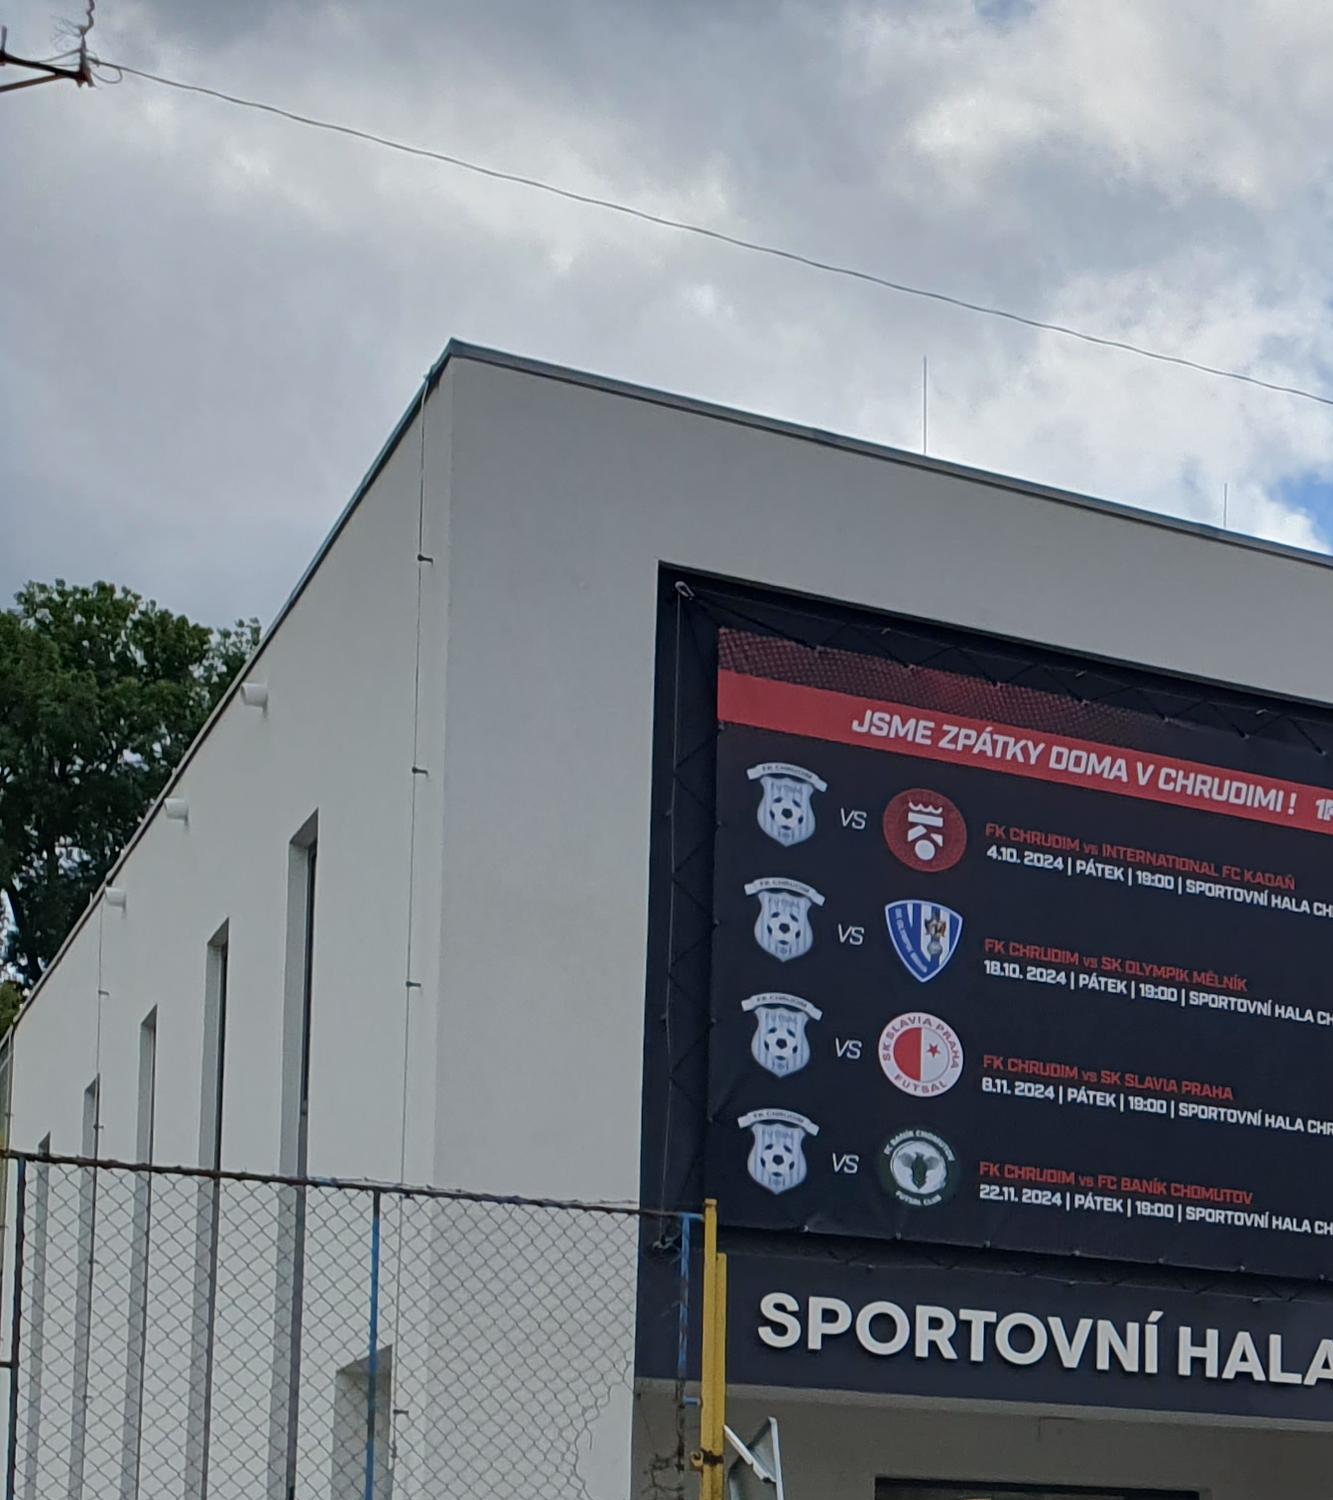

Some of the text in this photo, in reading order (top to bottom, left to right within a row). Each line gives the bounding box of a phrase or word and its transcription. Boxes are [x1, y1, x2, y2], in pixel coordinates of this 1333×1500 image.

[852, 709, 935, 745] JSME
[939, 725, 1045, 765] ZPÁTKY
[1049, 745, 1128, 782] DOMA
[1136, 761, 1154, 786] V
[1158, 767, 1284, 812] CHRUDIMI
[840, 807, 867, 830] VS
[985, 823, 1006, 839] FK
[1009, 827, 1080, 851] CHRUDIM
[1083, 842, 1098, 854] vs
[1102, 843, 1218, 877] INTERNATIONAL
[1222, 865, 1241, 881] FC
[986, 845, 1021, 863] 4.10.
[1024, 851, 1064, 870] 2024
[1076, 858, 1124, 882] PÁTEK
[1136, 870, 1174, 889] 19:00
[1186, 879, 1268, 906] SPORTOVNÍ
[1271, 894, 1310, 914] HALA
[838, 923, 865, 945] VS
[985, 939, 1247, 991] FK CHRUDIM vs SK OLYMPIK MĚLNÍK
[984, 960, 1023, 979] 18.10.
[1026, 967, 1066, 985] 2024
[1079, 973, 1127, 995] PÁTEK
[1139, 983, 1177, 1002] 19:00
[1189, 991, 1272, 1016] SPORTOVNÍ
[1275, 1004, 1314, 1023] HALA
[835, 1038, 862, 1060] VS
[882, 1016, 960, 1070] SK SLAVIA PRAHA
[894, 1073, 948, 1094] FUTSAL
[983, 1054, 1233, 1100] FK CHRUDIM vs SK SLAVIA PRAHA
[982, 1077, 1011, 1095] 8.11.
[1015, 1081, 1055, 1100] 2024
[1067, 1086, 1116, 1108] PÁTEK
[1128, 1096, 1167, 1114] 19:00
[1178, 1102, 1262, 1126] SPORTOVNÍ
[1265, 1113, 1304, 1132] HALA
[832, 1152, 859, 1174] VS
[980, 1161, 1253, 1205] FK CHRUDIM vs FC BANÍK CHOMUTOV
[980, 1184, 1018, 1202] 22.11.
[1022, 1188, 1062, 1207] 2024
[1075, 1192, 1123, 1213] PÁTEK
[1135, 1201, 1174, 1218] 19:00
[1186, 1206, 1268, 1228] SPORTOVNÍ
[1272, 1216, 1311, 1233] HALA
[757, 1291, 1164, 1375] SPORTOVNÍ
